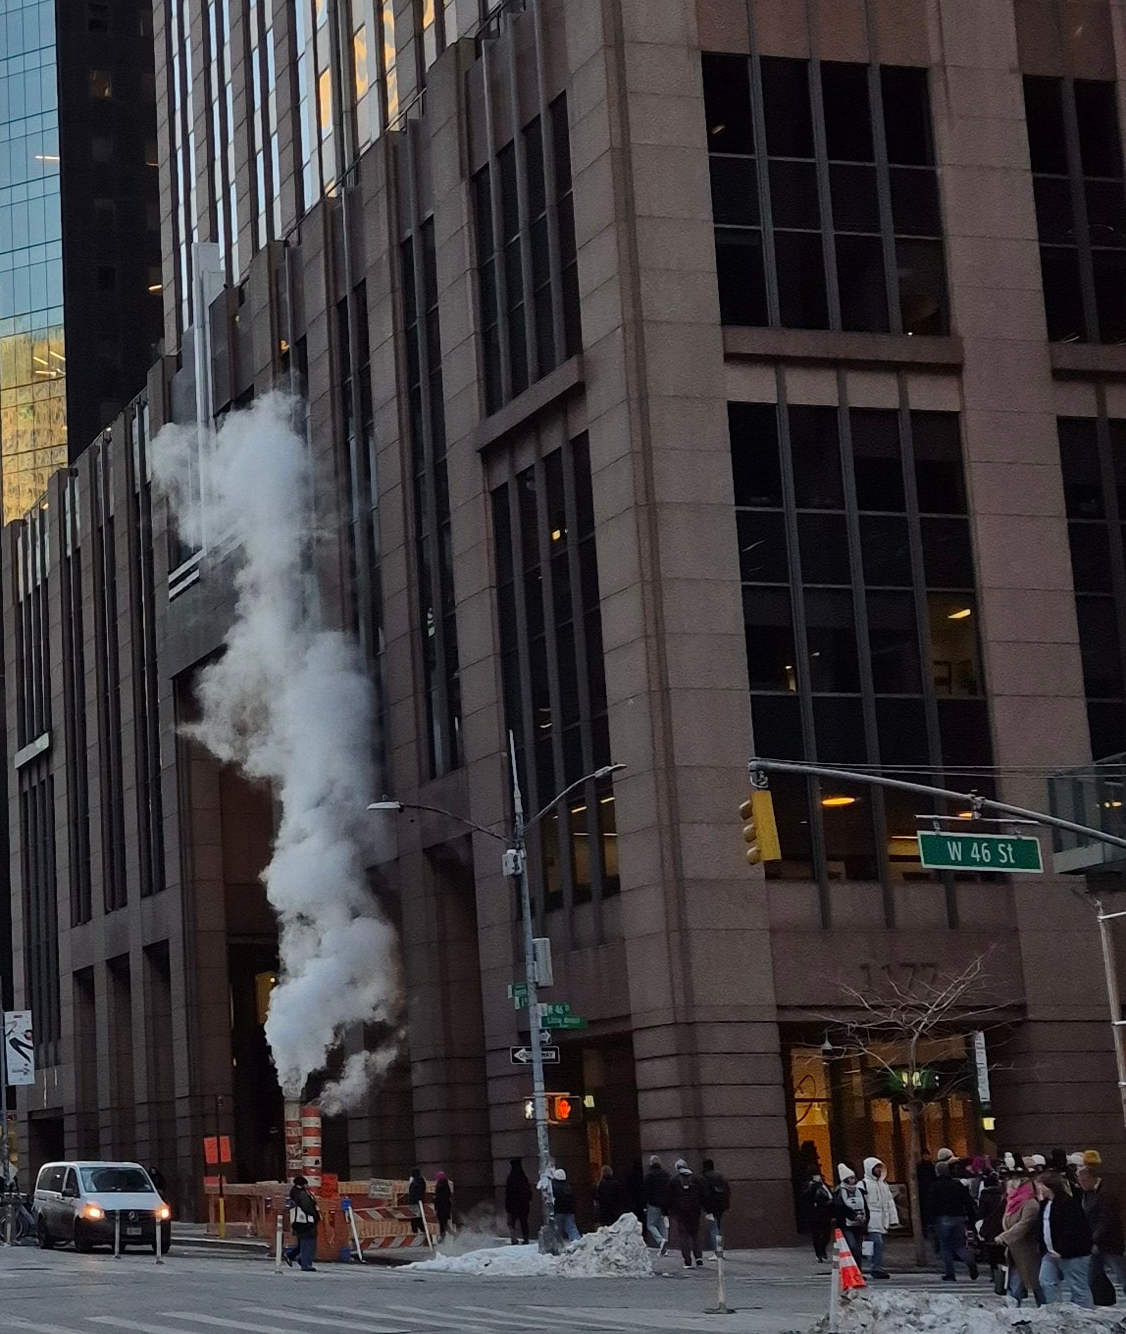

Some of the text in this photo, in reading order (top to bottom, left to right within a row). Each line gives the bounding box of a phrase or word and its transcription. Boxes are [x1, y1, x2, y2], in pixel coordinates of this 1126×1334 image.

[947, 840, 1015, 864] W 46 St
[859, 962, 938, 998] 1177
